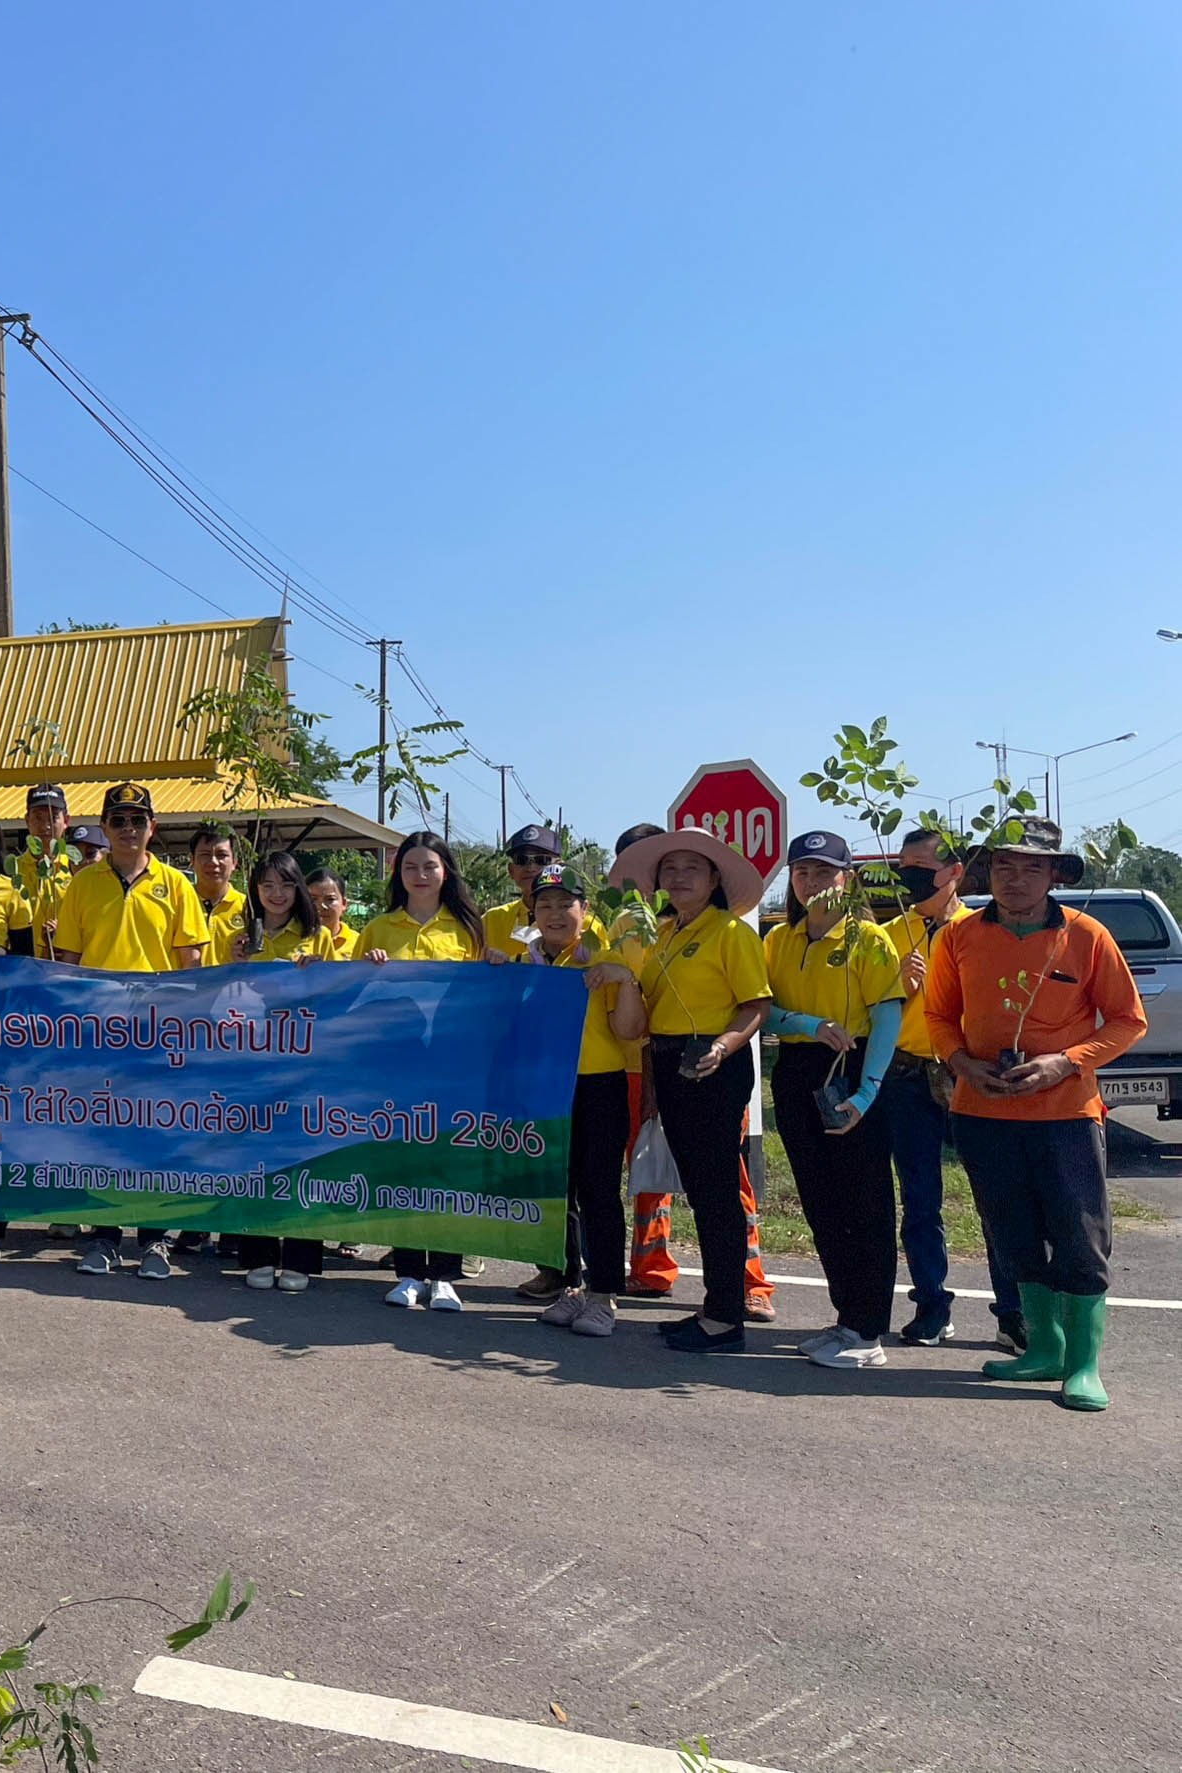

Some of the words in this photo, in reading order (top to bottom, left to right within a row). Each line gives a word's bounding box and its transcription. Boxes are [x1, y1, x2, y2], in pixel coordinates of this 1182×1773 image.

[1133, 1081, 1163, 1093] 9543
[302, 1096, 438, 1144] ประจำปี
[450, 1110, 546, 1157] 2566
[8, 1162, 27, 1188] 2
[33, 1160, 266, 1199] สำนักงานทางหลวงที่
[272, 1174, 291, 1201] 2
[297, 1168, 369, 1213] (แพร่)
[376, 1184, 543, 1225] กรมทางหลวง
